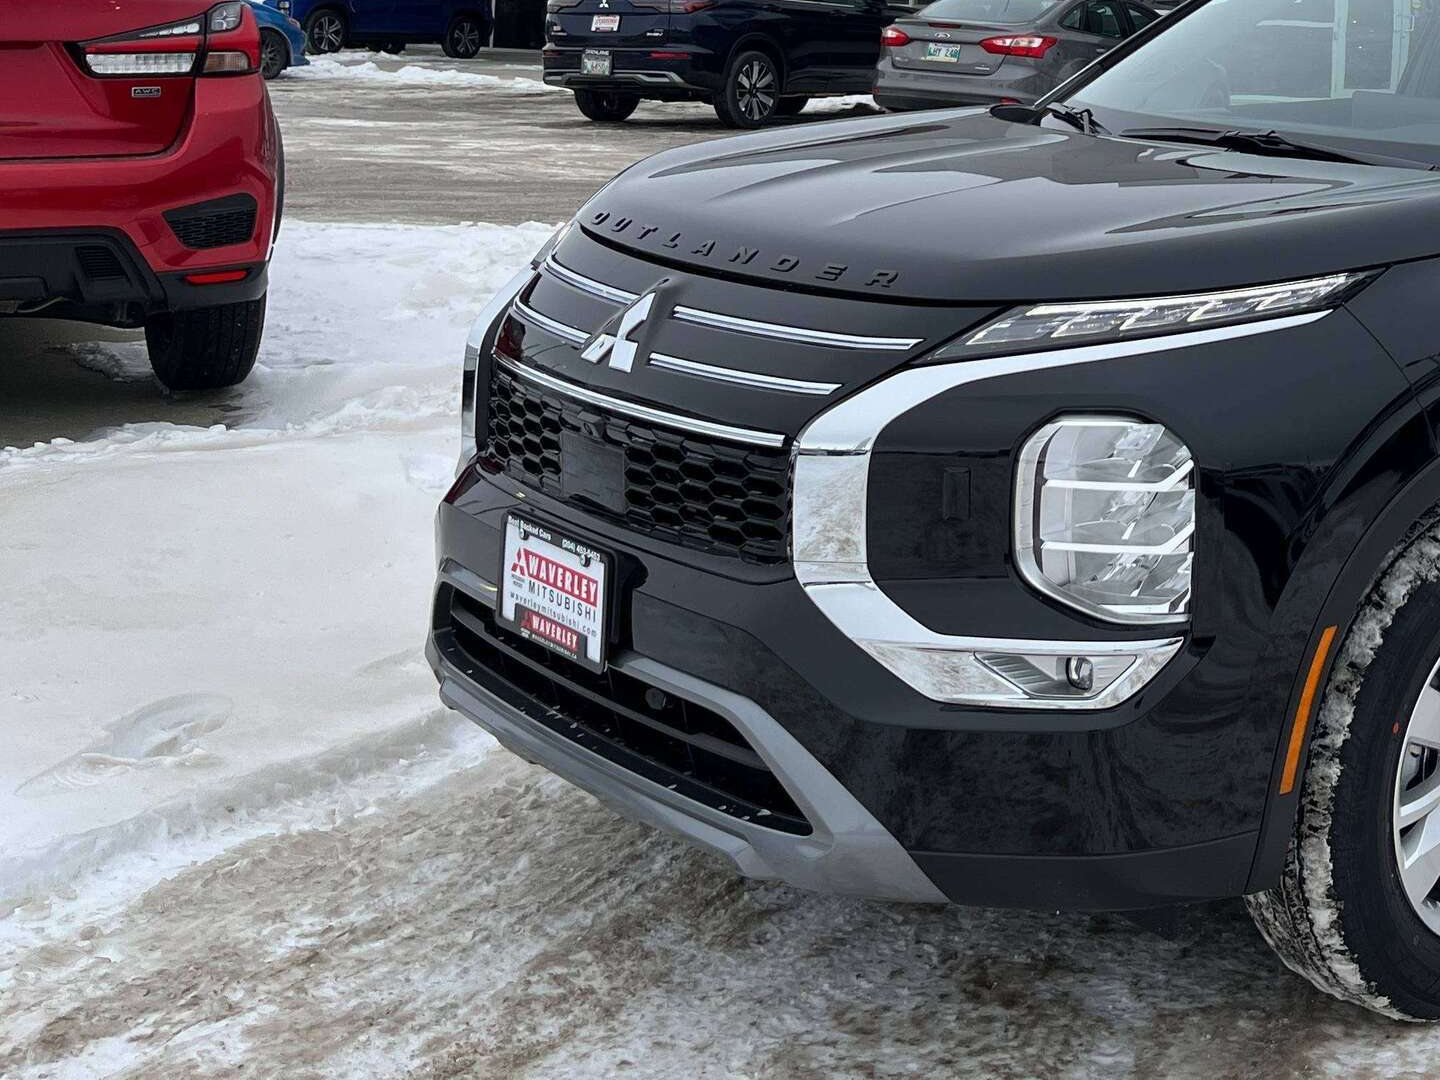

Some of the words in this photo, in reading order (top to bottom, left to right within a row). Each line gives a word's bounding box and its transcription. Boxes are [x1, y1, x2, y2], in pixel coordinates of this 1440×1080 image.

[592, 212, 899, 289] OUTLANDER
[529, 554, 597, 602] WAVERLEY
[529, 580, 597, 623] MITSUBISHI
[511, 591, 597, 638] waverleymitsubishi.com
[532, 614, 578, 649] WAVERLEY
